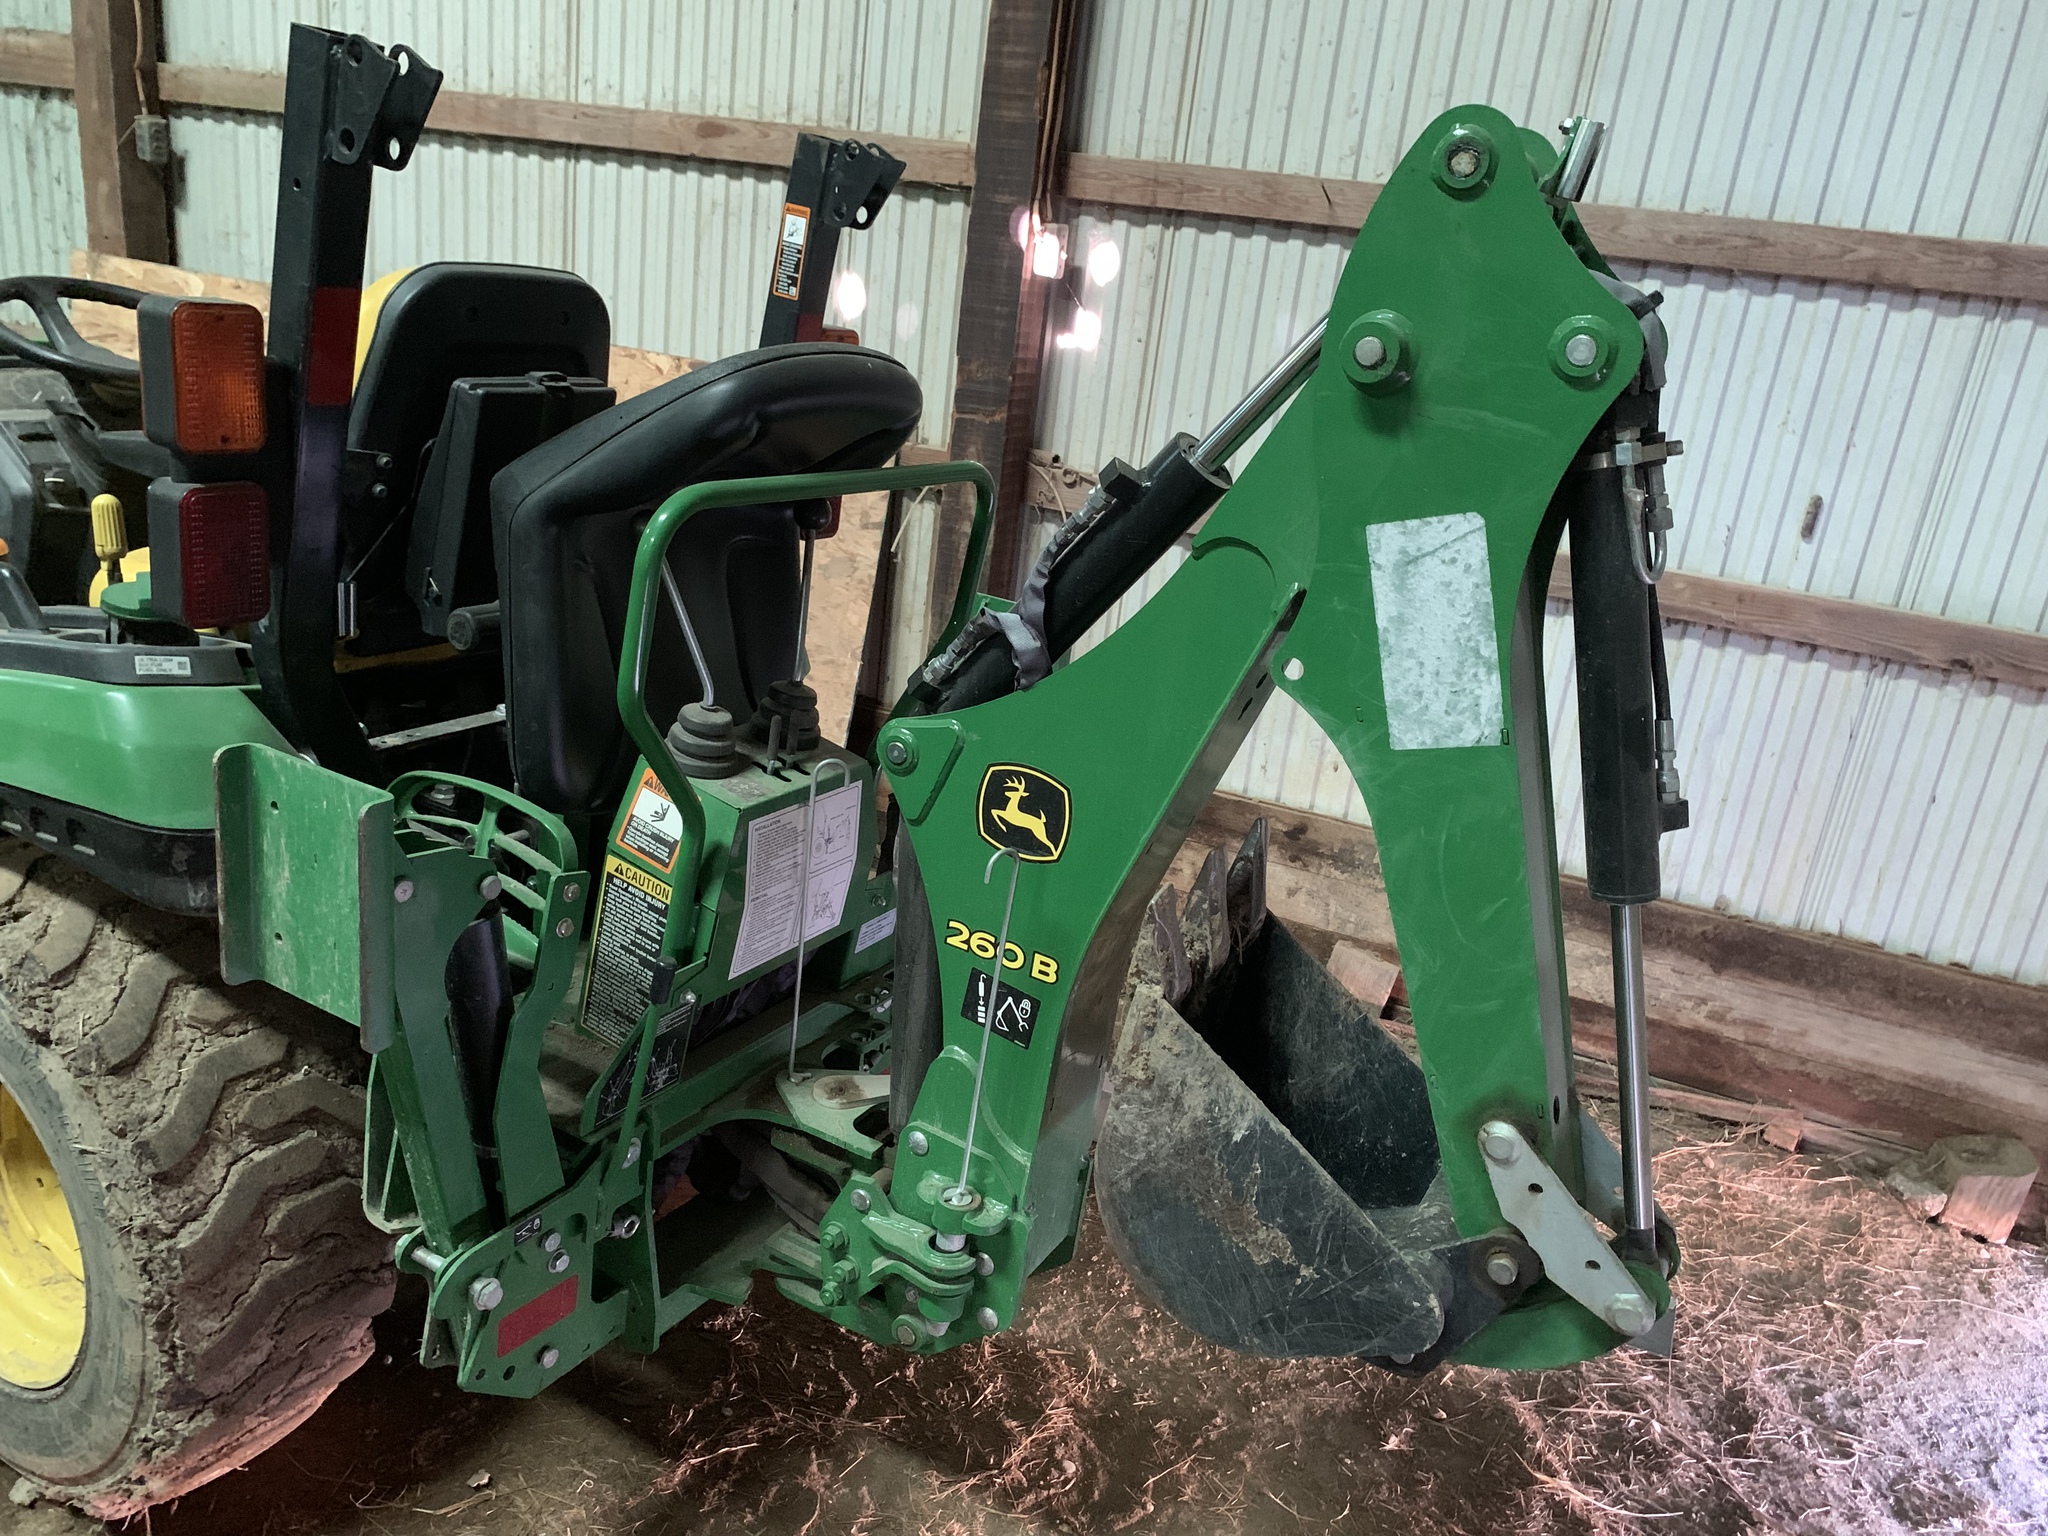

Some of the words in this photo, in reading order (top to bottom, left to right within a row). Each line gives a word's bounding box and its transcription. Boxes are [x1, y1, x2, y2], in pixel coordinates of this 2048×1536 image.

[613, 877, 628, 889] HELP
[628, 885, 645, 899] AVOID
[645, 895, 666, 911] INJURY
[625, 867, 670, 901] CAUTION
[945, 920, 1025, 971] 260
[1031, 952, 1059, 984] B
